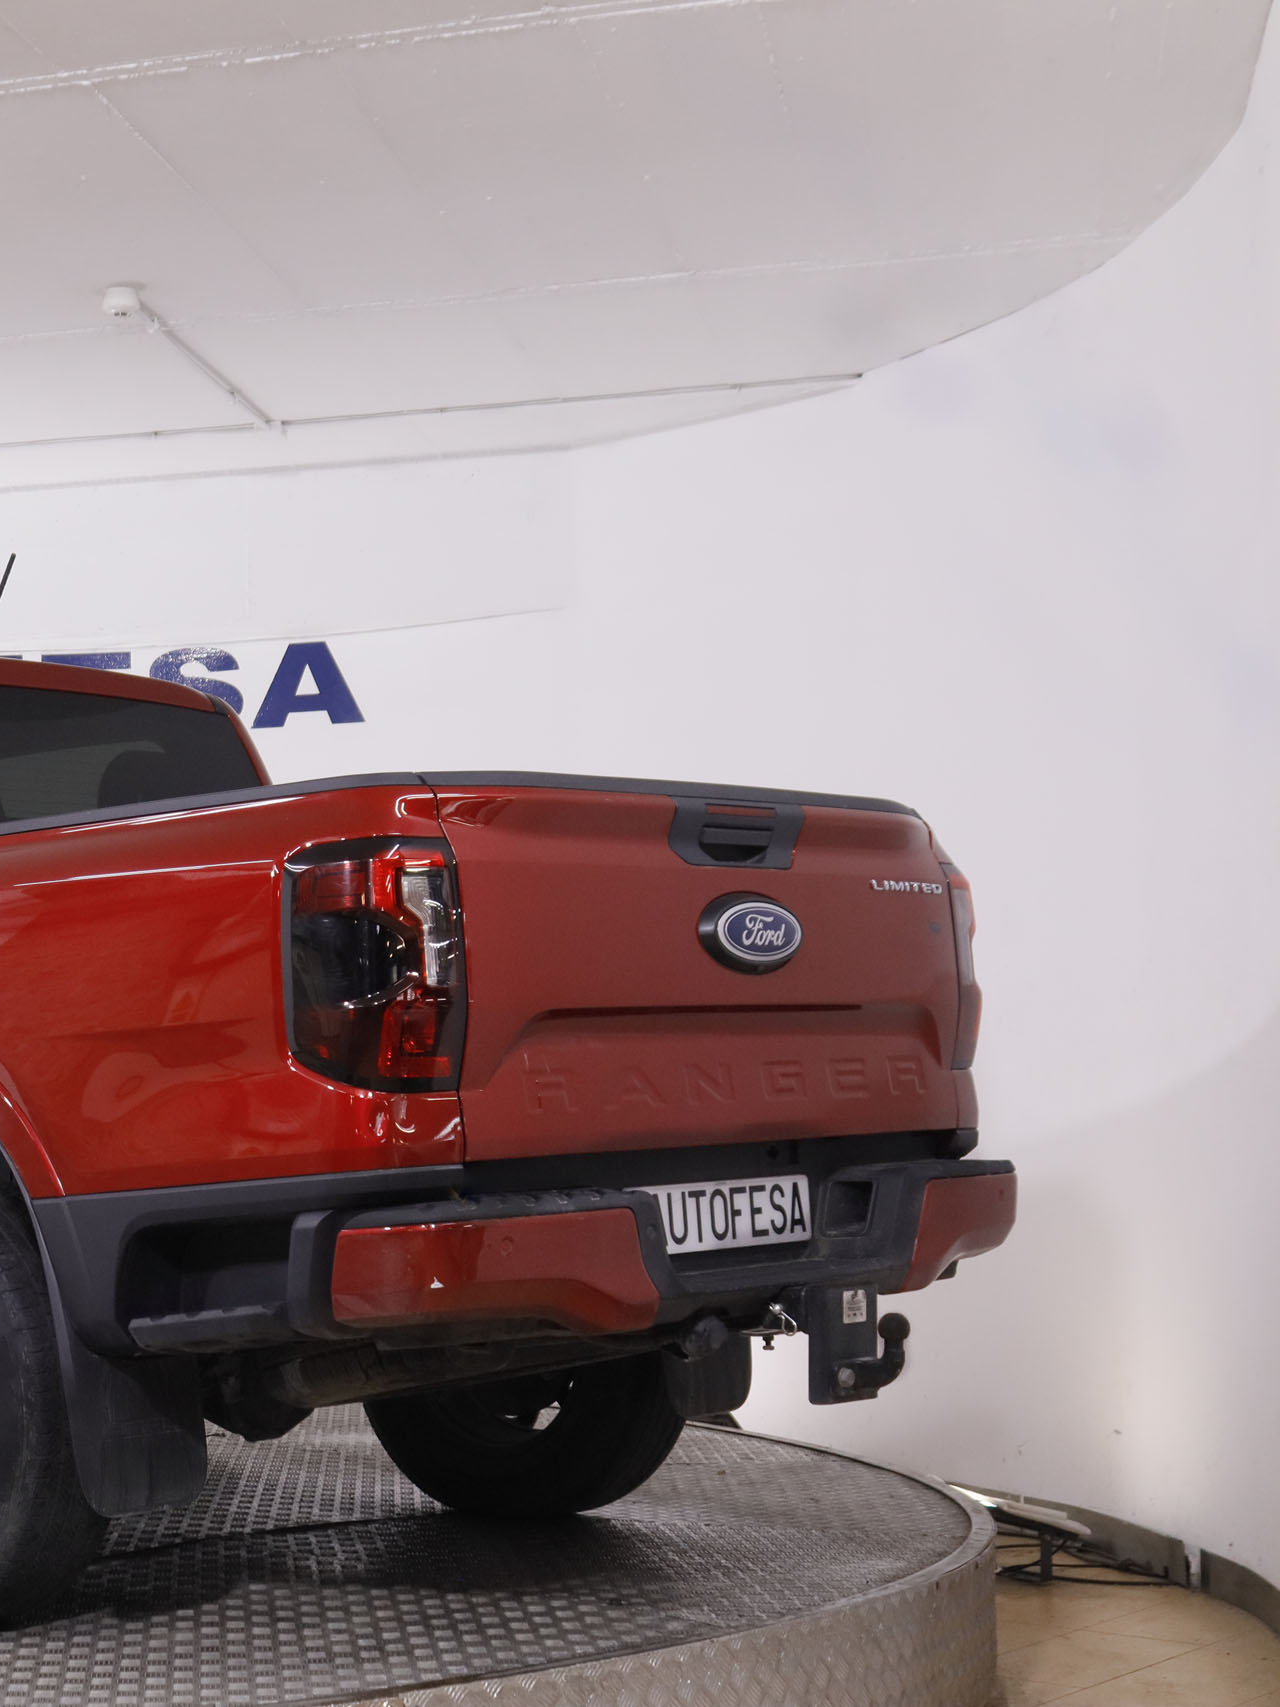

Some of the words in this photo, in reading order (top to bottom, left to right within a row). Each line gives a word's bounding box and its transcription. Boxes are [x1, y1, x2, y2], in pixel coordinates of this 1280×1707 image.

[870, 878, 943, 895] LIMITED
[741, 913, 787, 948] Ford
[524, 1054, 925, 1115] RANGER
[656, 1180, 808, 1246] UTOFESA
